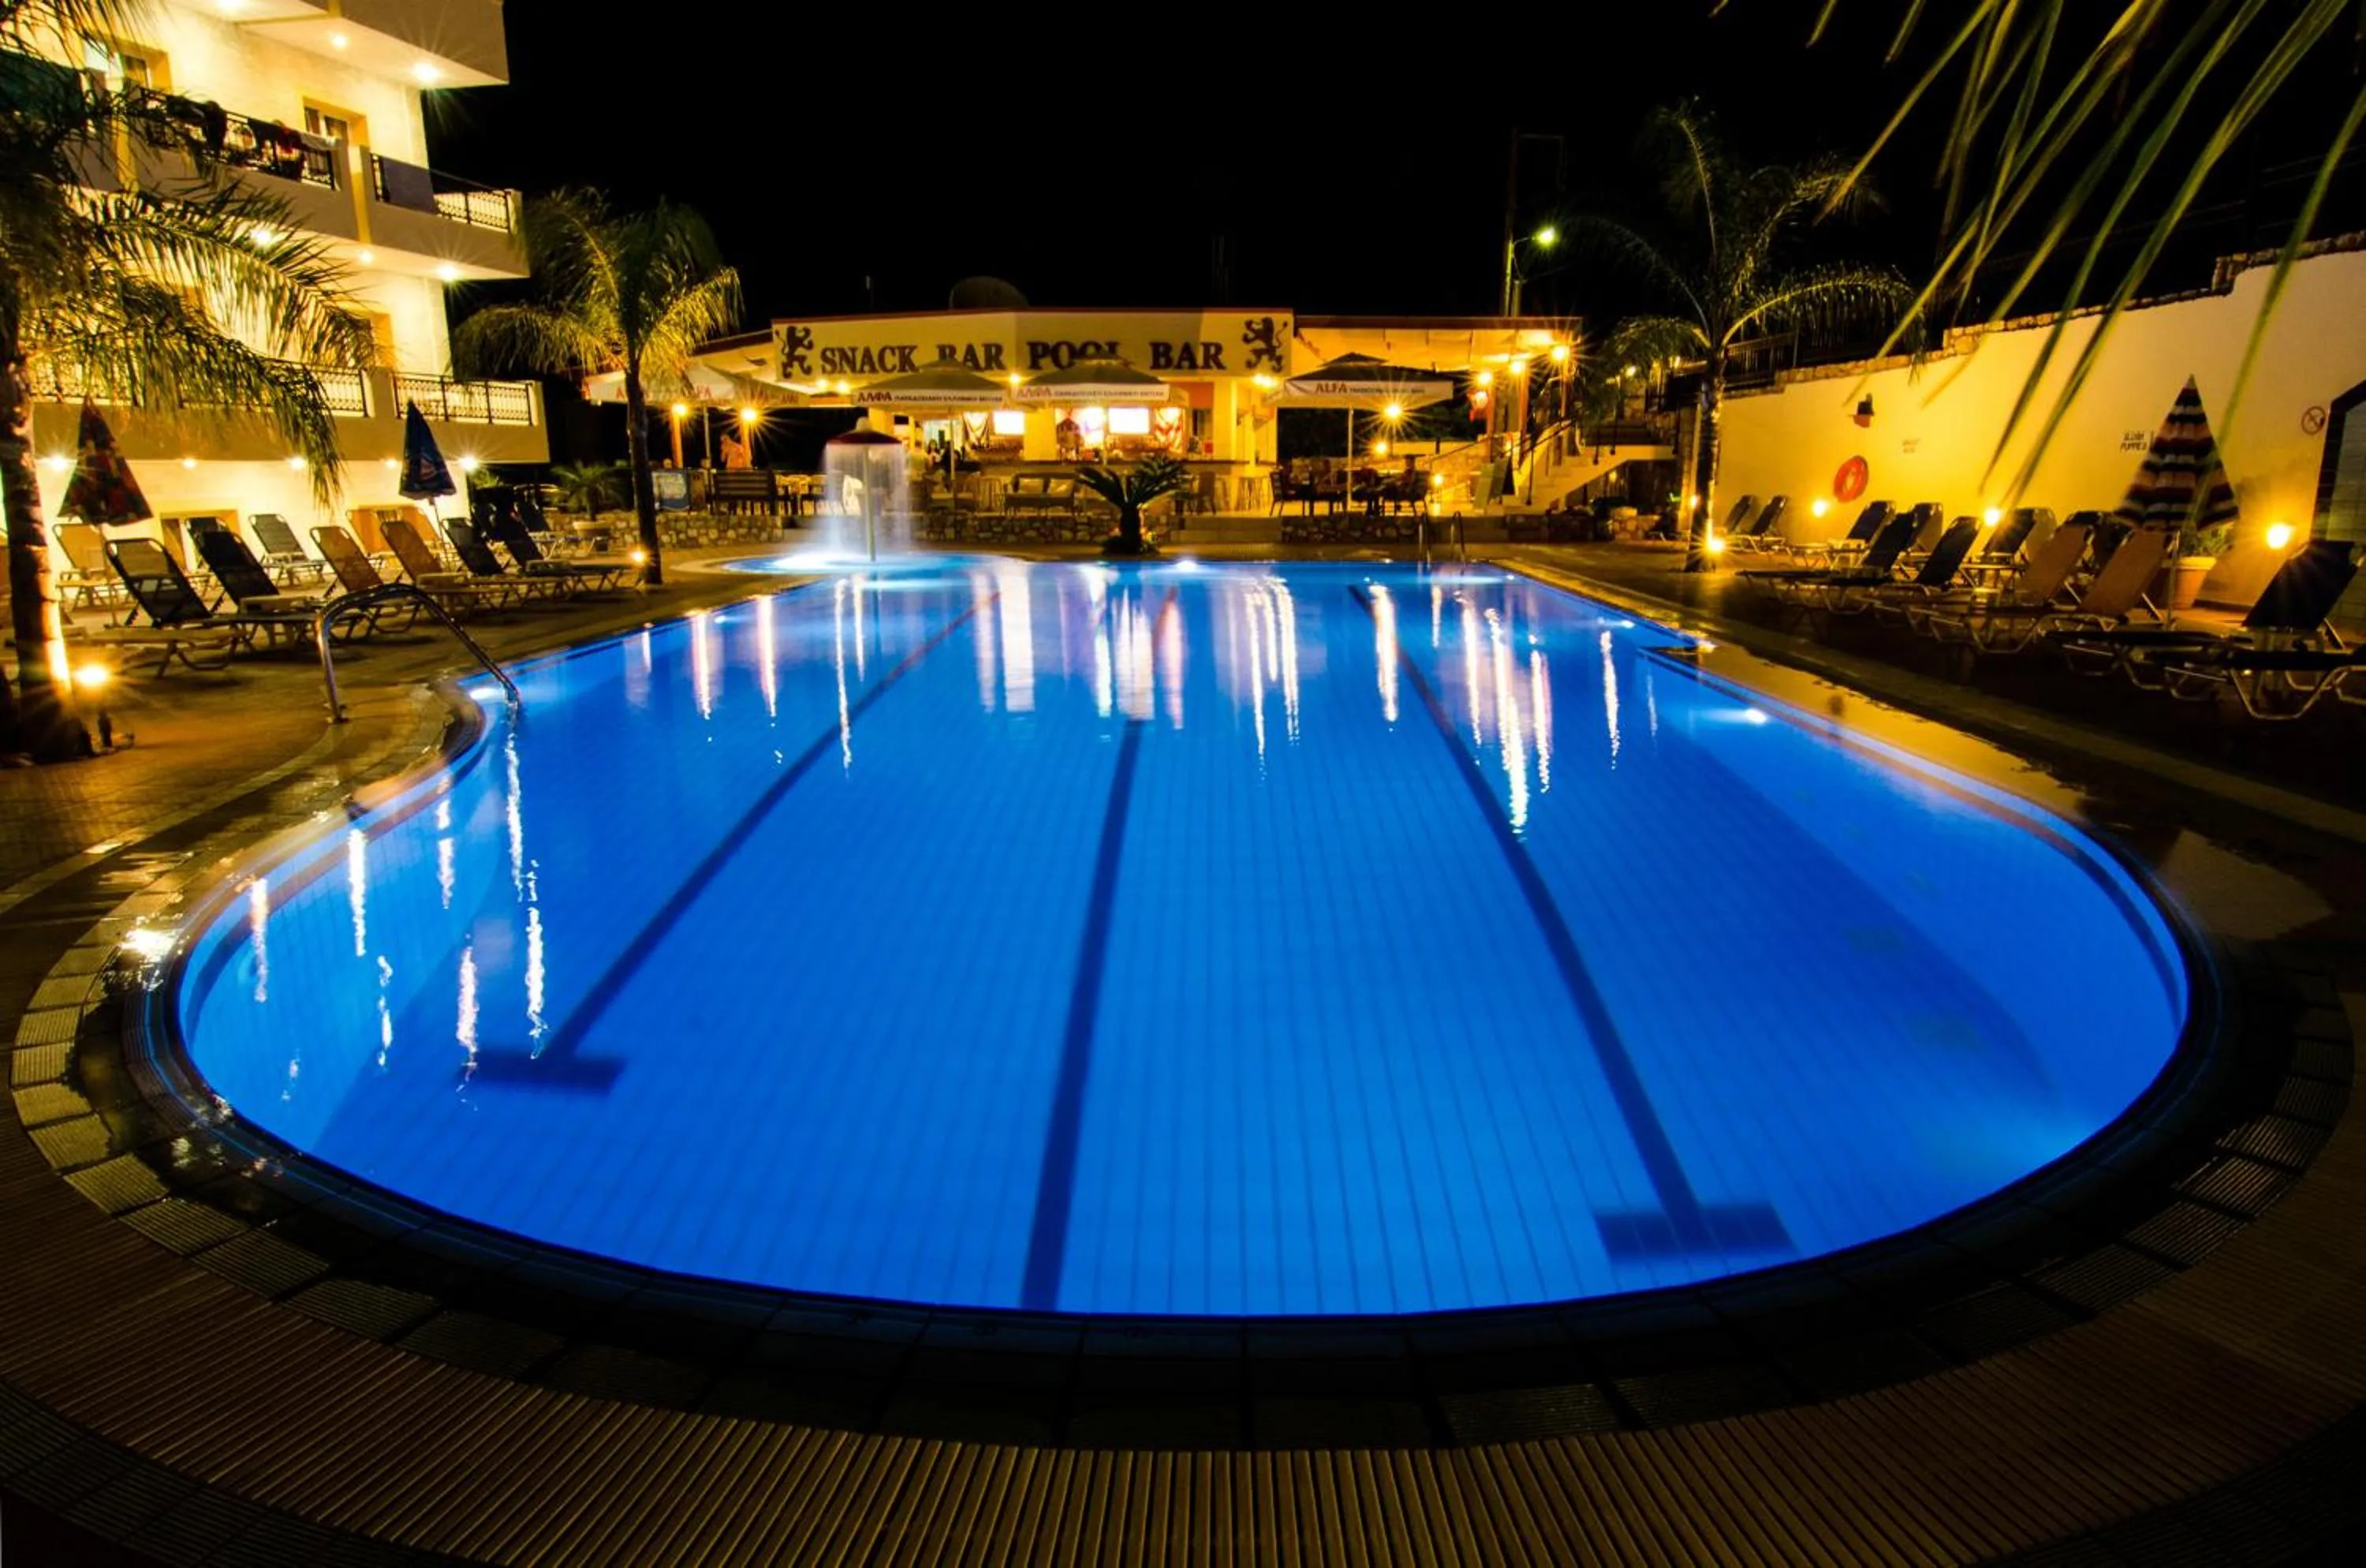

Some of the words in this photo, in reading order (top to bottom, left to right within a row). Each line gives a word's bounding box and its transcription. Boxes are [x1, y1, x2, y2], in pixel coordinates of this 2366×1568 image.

[820, 345, 920, 374] SNACK
[936, 342, 1006, 371] BAR
[1148, 342, 1226, 370] BAR
[1315, 383, 1348, 394] ALFA
